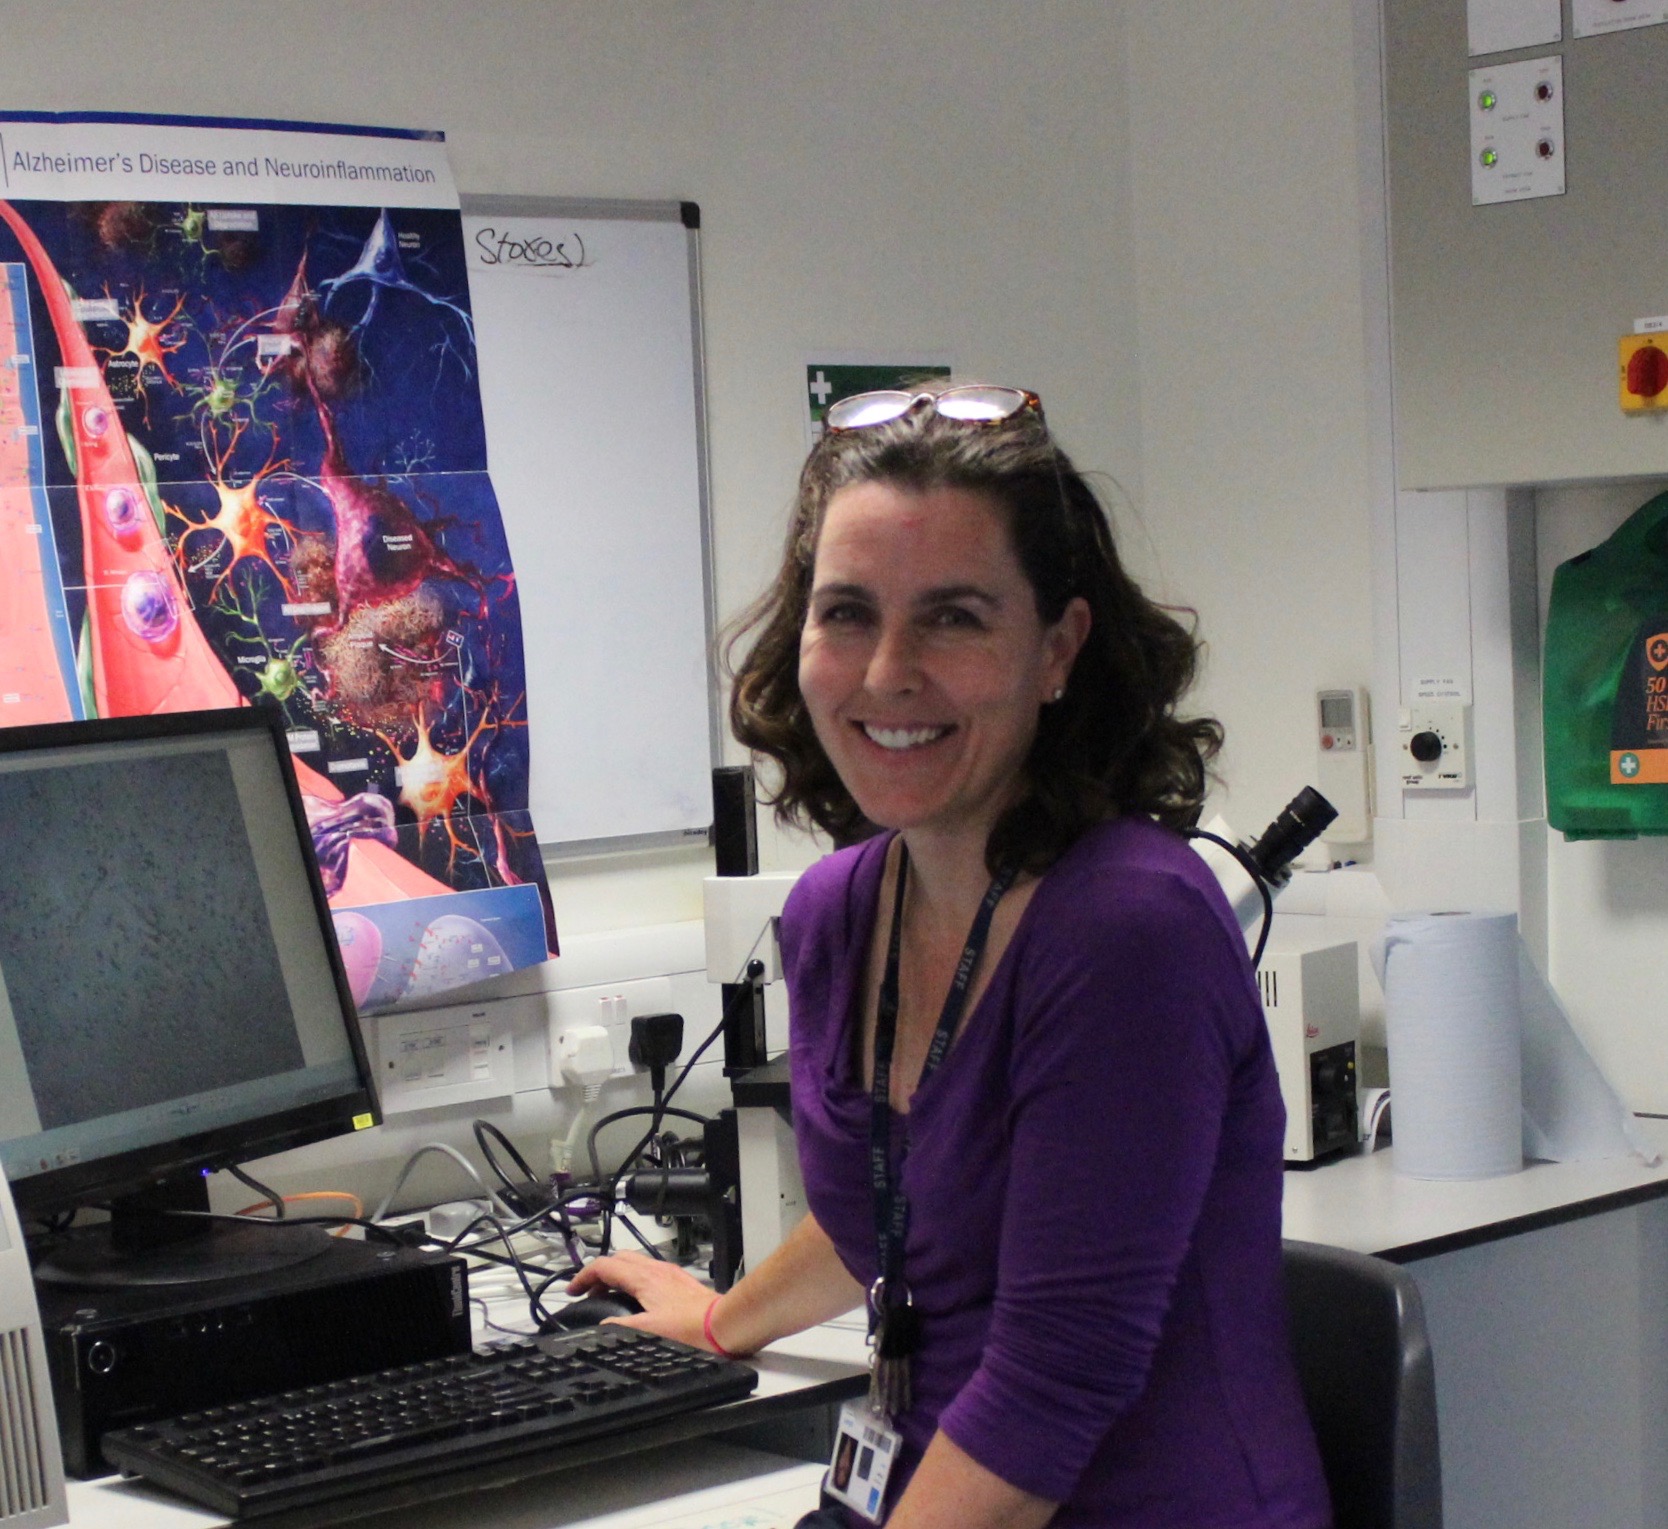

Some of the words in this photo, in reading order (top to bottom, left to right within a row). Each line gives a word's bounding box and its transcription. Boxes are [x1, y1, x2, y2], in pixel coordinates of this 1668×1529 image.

[13, 151, 133, 173] Alzheimer's
[139, 153, 217, 176] Disease
[222, 157, 258, 177] and
[264, 157, 436, 183] Neuroinflammation
[153, 452, 180, 462] Pericyte
[382, 534, 413, 543] Diseased
[386, 543, 412, 551] Neuron
[1646, 676, 1667, 693] 50
[1646, 695, 1668, 712] HS
[956, 947, 976, 990] STAFF
[873, 1146, 887, 1189] STAFF
